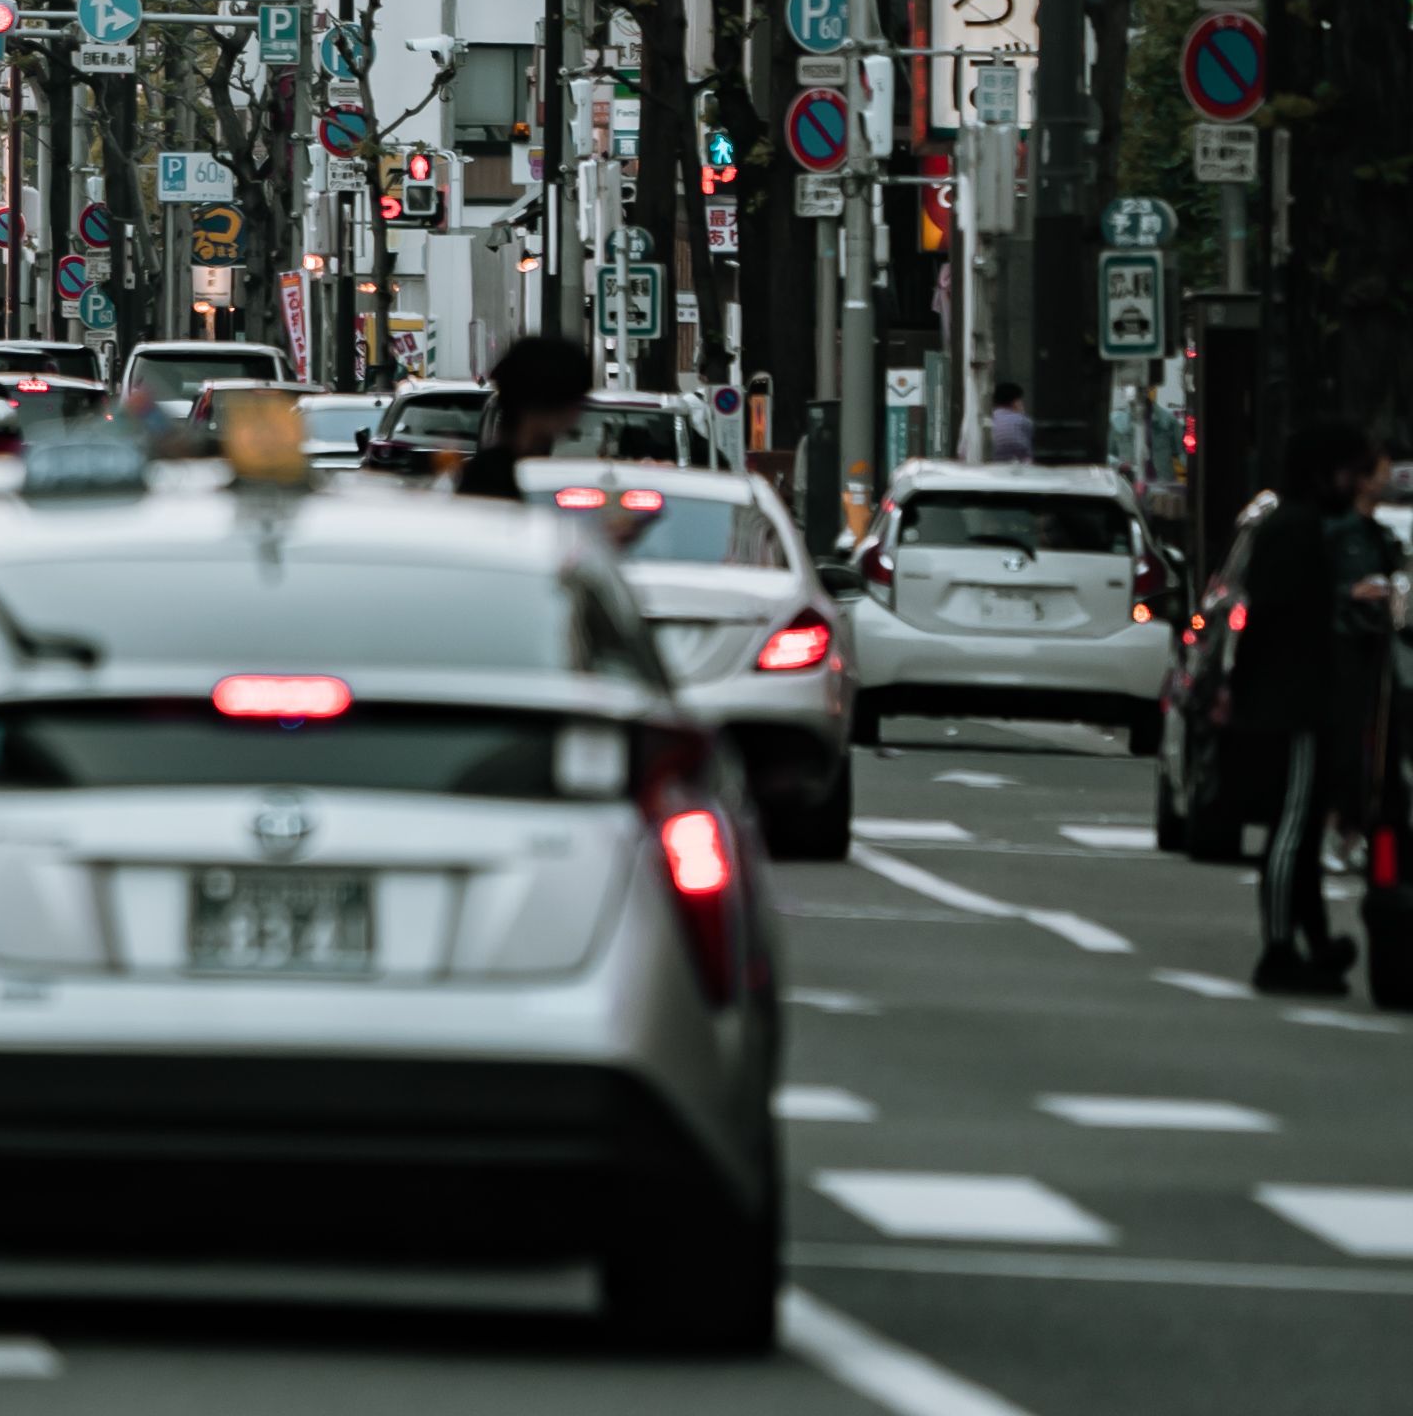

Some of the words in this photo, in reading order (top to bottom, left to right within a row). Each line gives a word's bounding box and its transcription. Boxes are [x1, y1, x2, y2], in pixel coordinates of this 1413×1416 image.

[269, 9, 293, 40] P
[82, 51, 133, 68] 自転車を除く
[88, 294, 106, 324] P
